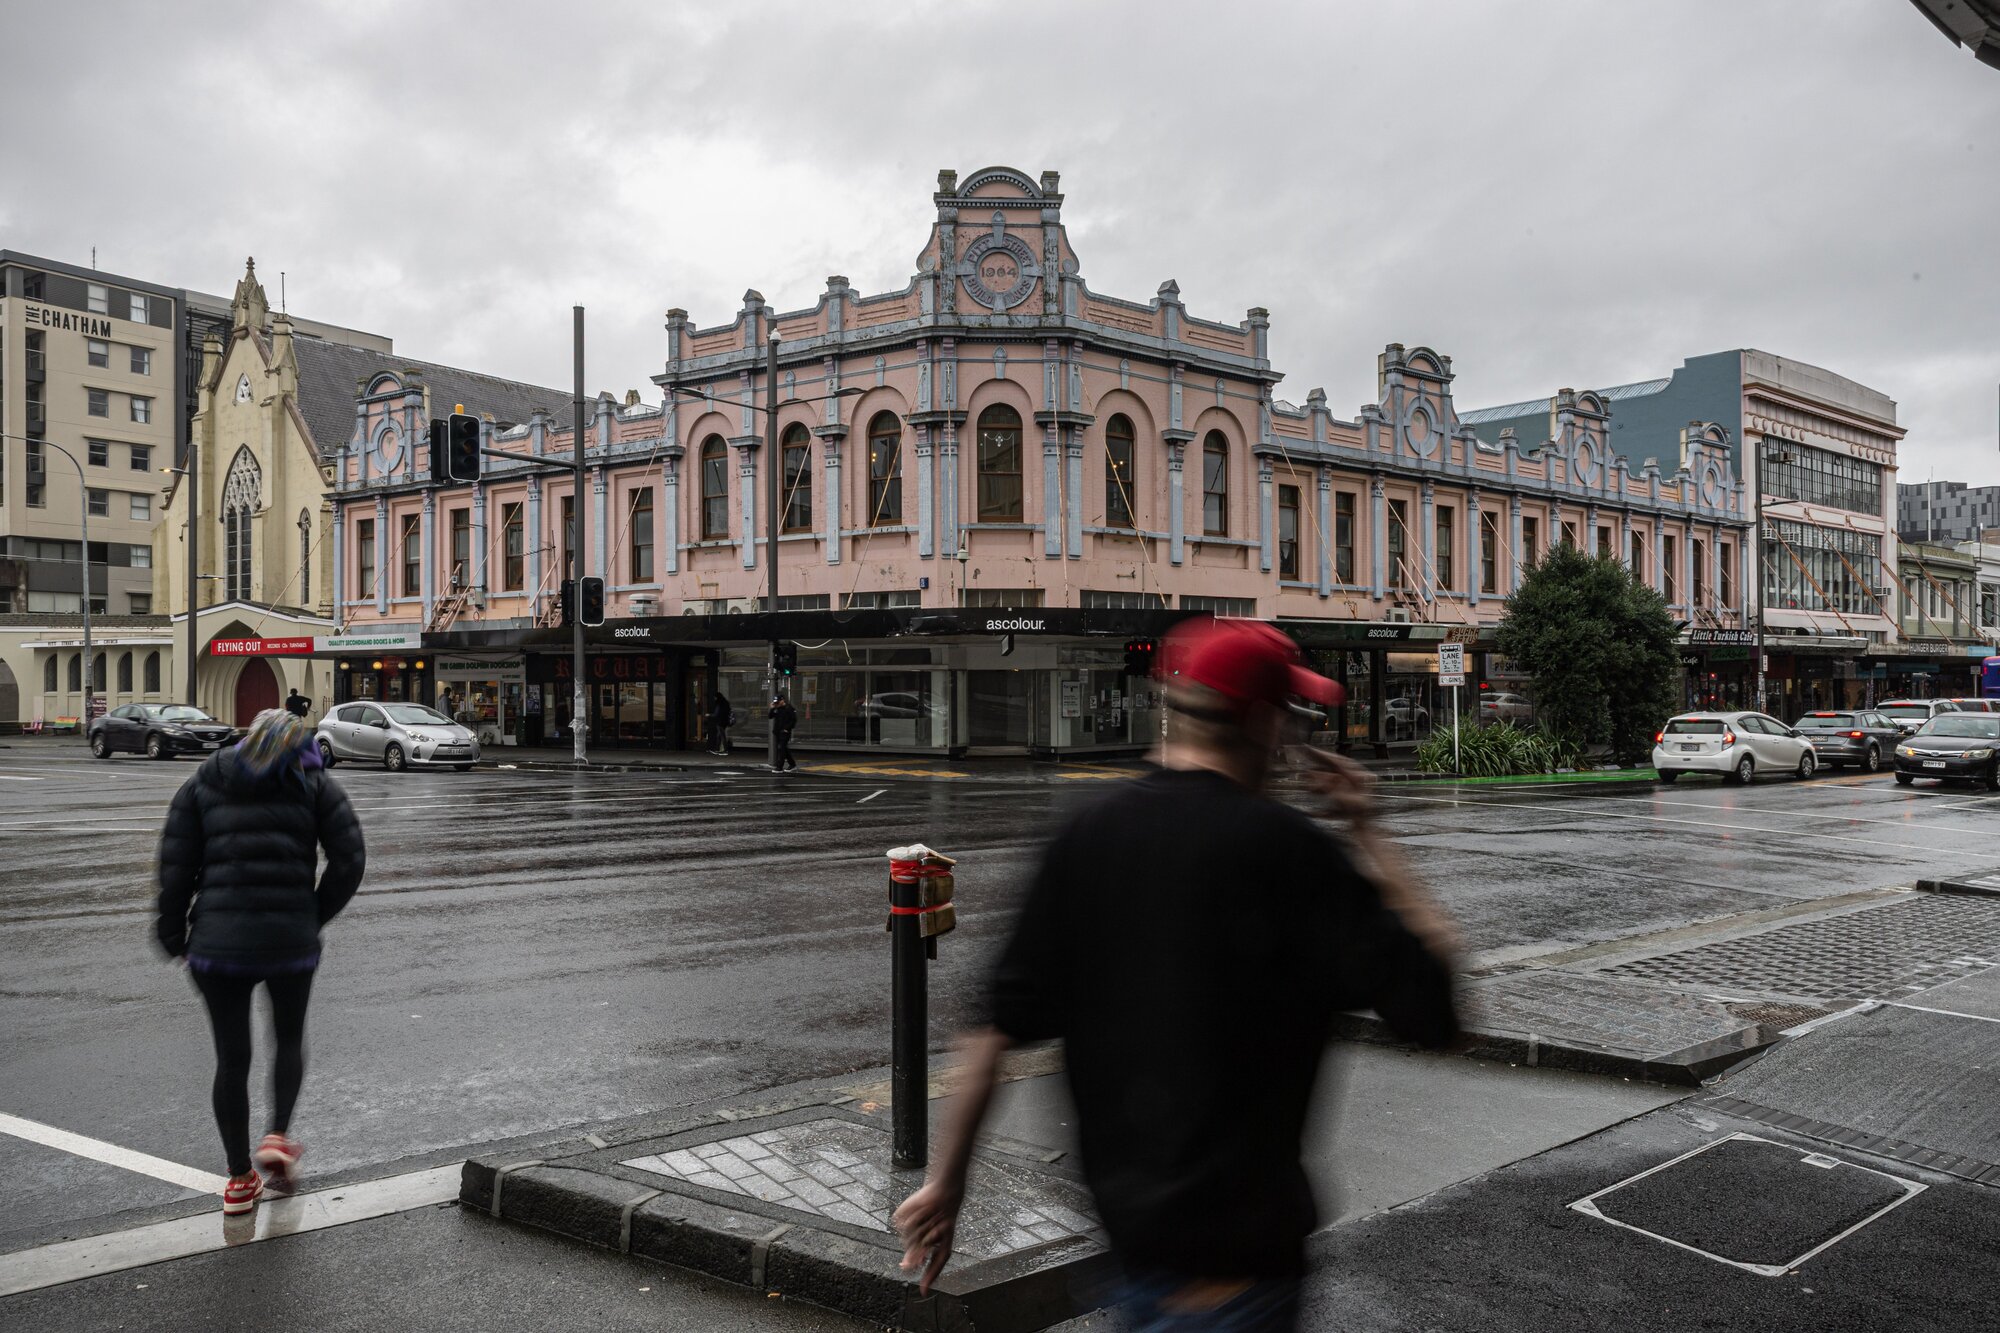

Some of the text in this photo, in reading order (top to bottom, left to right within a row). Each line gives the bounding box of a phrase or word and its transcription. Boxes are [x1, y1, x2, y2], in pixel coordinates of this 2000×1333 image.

[967, 238, 1034, 267] PITT STREET
[26, 305, 40, 323] THE
[42, 309, 111, 337] CHATHAM
[986, 617, 1046, 630] ascolour.
[614, 626, 651, 637] ascolour.
[1368, 627, 1398, 638] ascolour.
[1692, 629, 1712, 640] Little
[1713, 630, 1738, 641] Turkish
[217, 641, 261, 652] FLYING OUT
[1910, 643, 1948, 653] HUNGER BURGER
[555, 656, 666, 678] RTUAL
